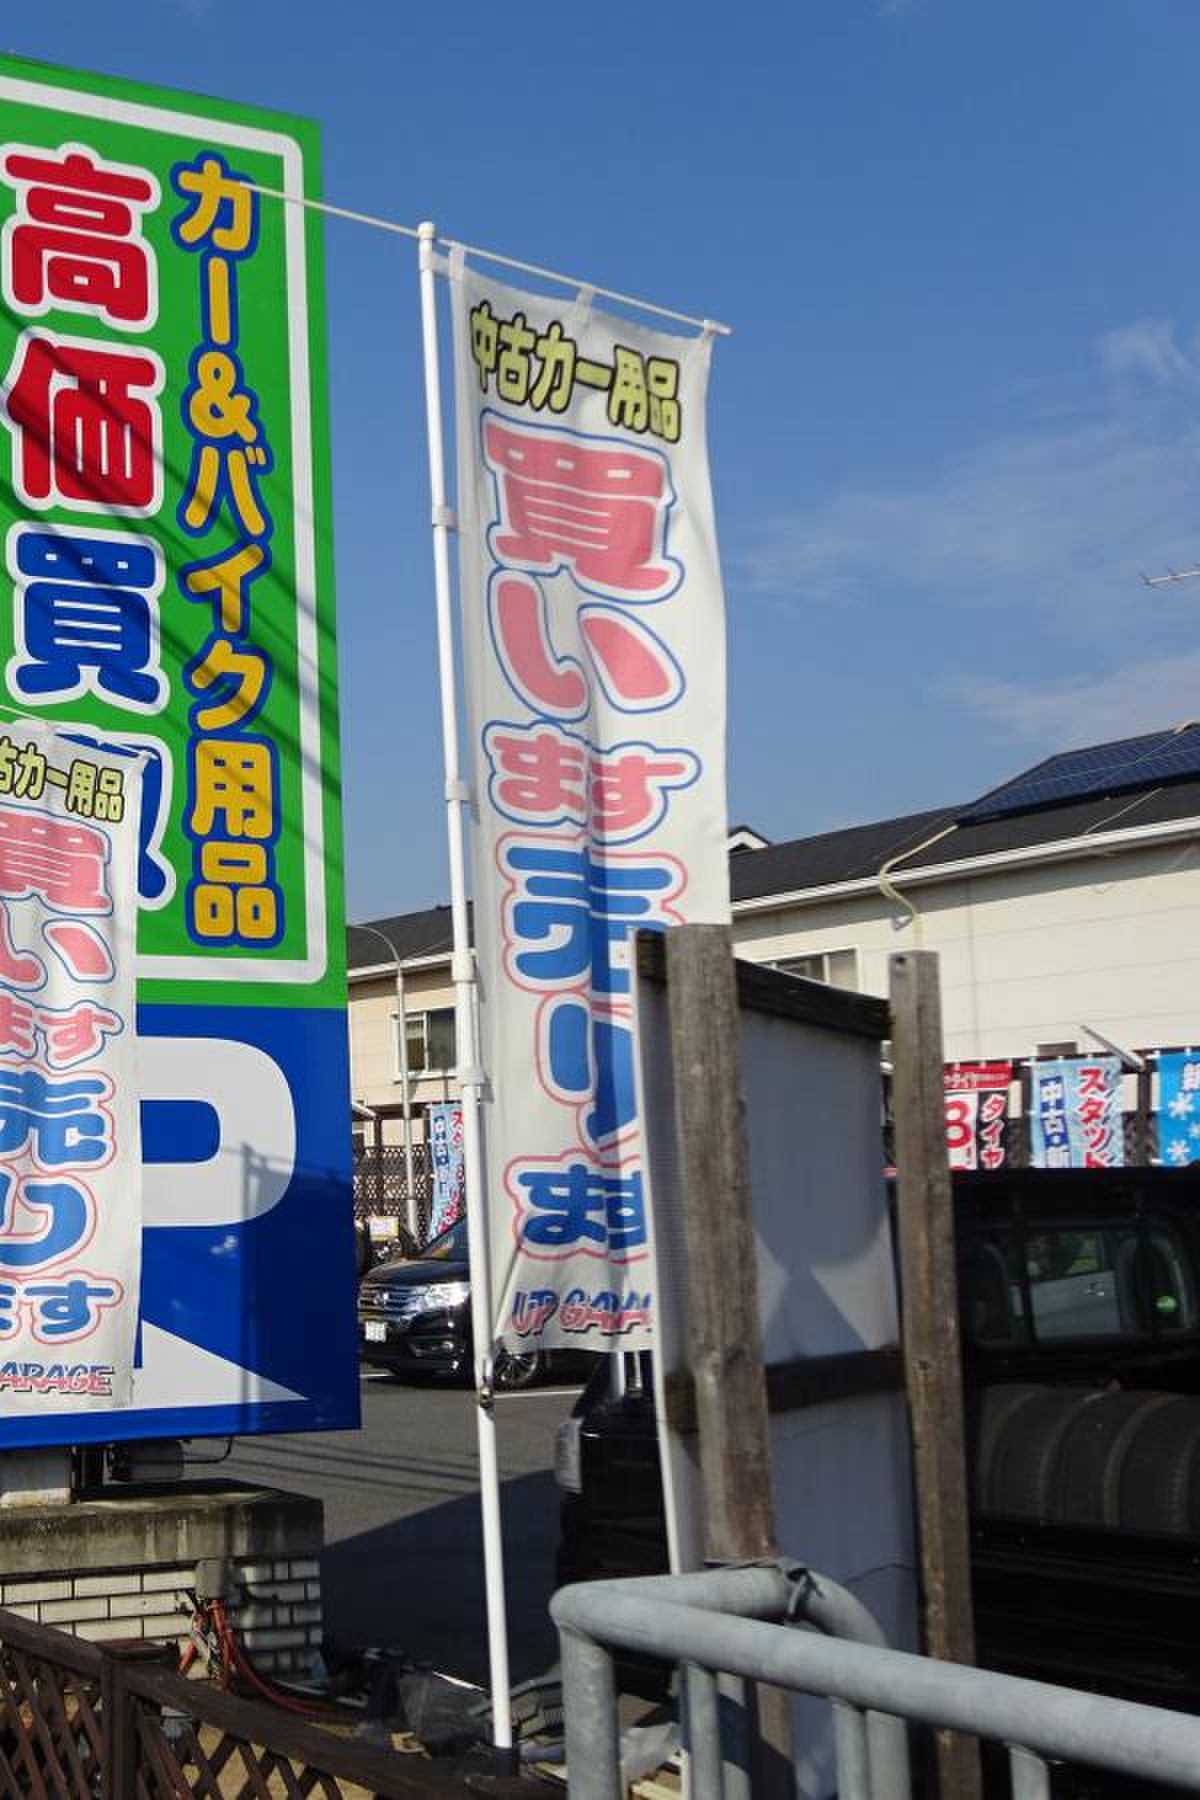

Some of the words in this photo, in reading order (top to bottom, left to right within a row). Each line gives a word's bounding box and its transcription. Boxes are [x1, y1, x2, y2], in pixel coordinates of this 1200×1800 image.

[469, 300, 682, 443] 中古カー用品
[170, 150, 286, 948] カー&バイク用品
[511, 1288, 560, 1338] UP
